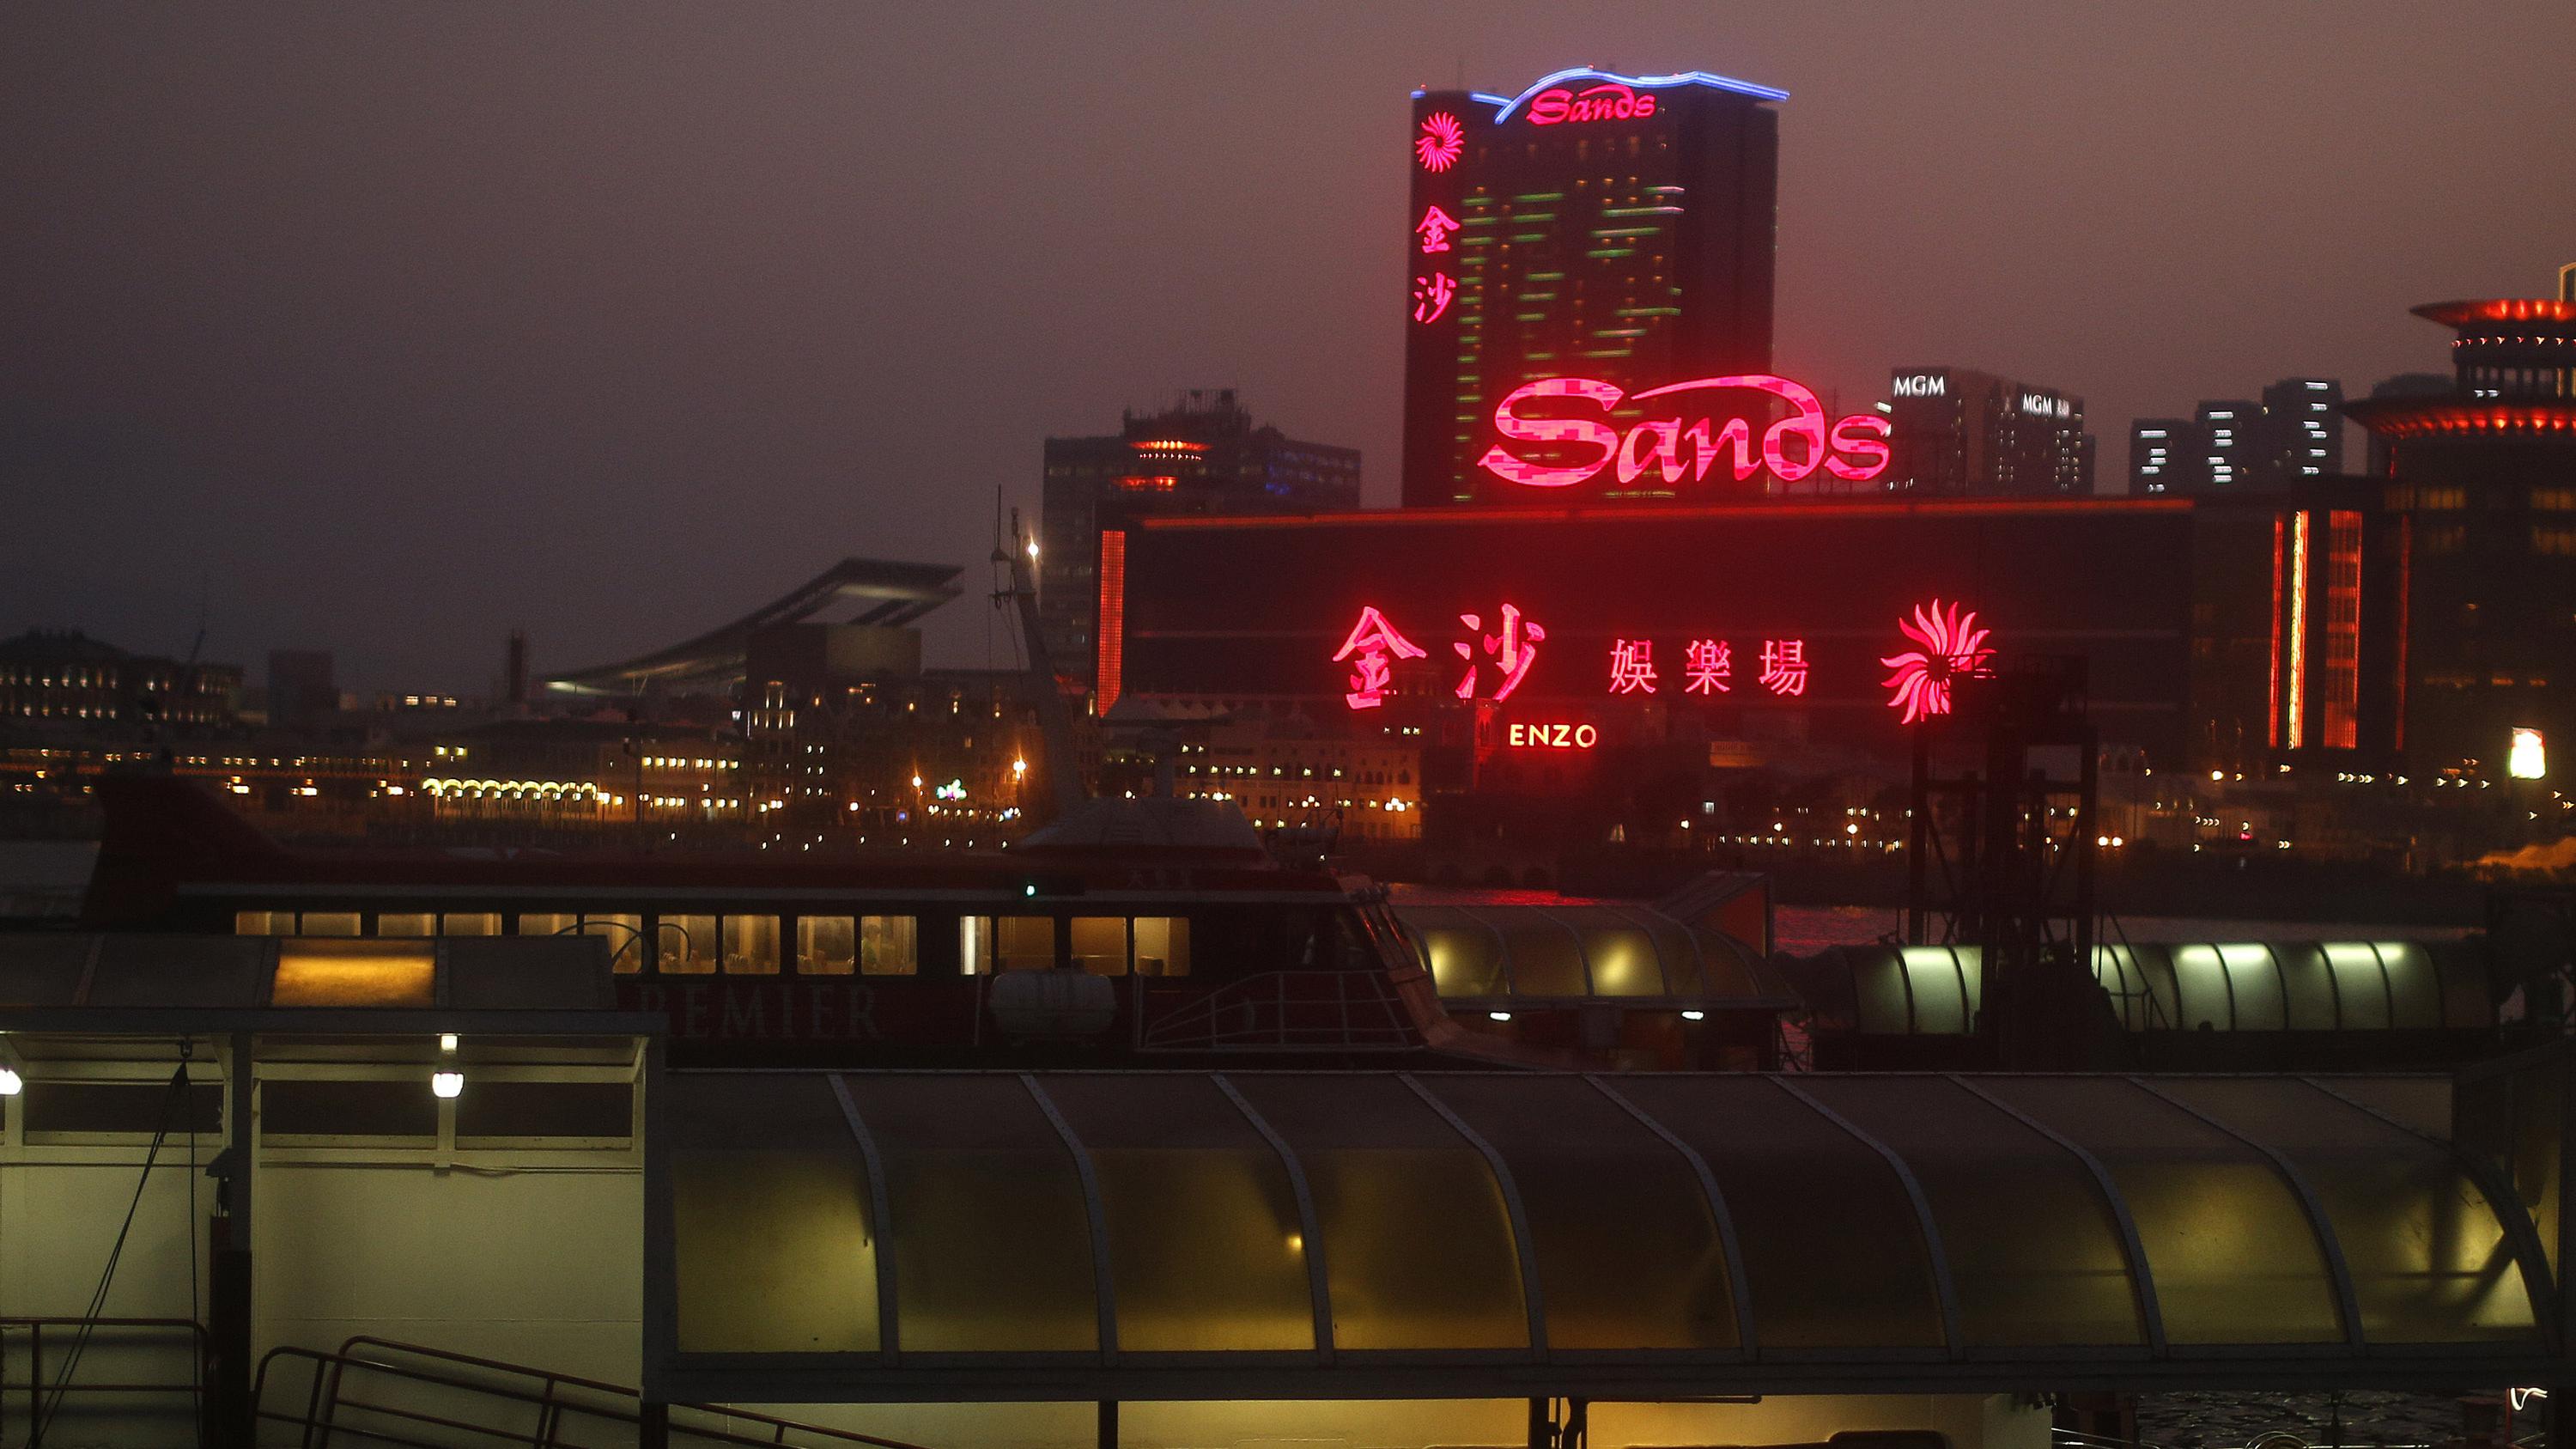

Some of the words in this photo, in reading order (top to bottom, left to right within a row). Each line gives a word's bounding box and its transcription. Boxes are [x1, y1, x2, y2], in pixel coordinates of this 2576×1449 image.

[1526, 84, 1656, 125] Sands
[1413, 205, 1460, 324] 金沙
[1893, 375, 1946, 397] MGM
[2022, 393, 2053, 416] MGM
[1478, 374, 1890, 486] Sands
[1333, 603, 1545, 709] 金沙
[1608, 638, 1809, 696] 娛樂場
[1510, 723, 1596, 748] ENZO
